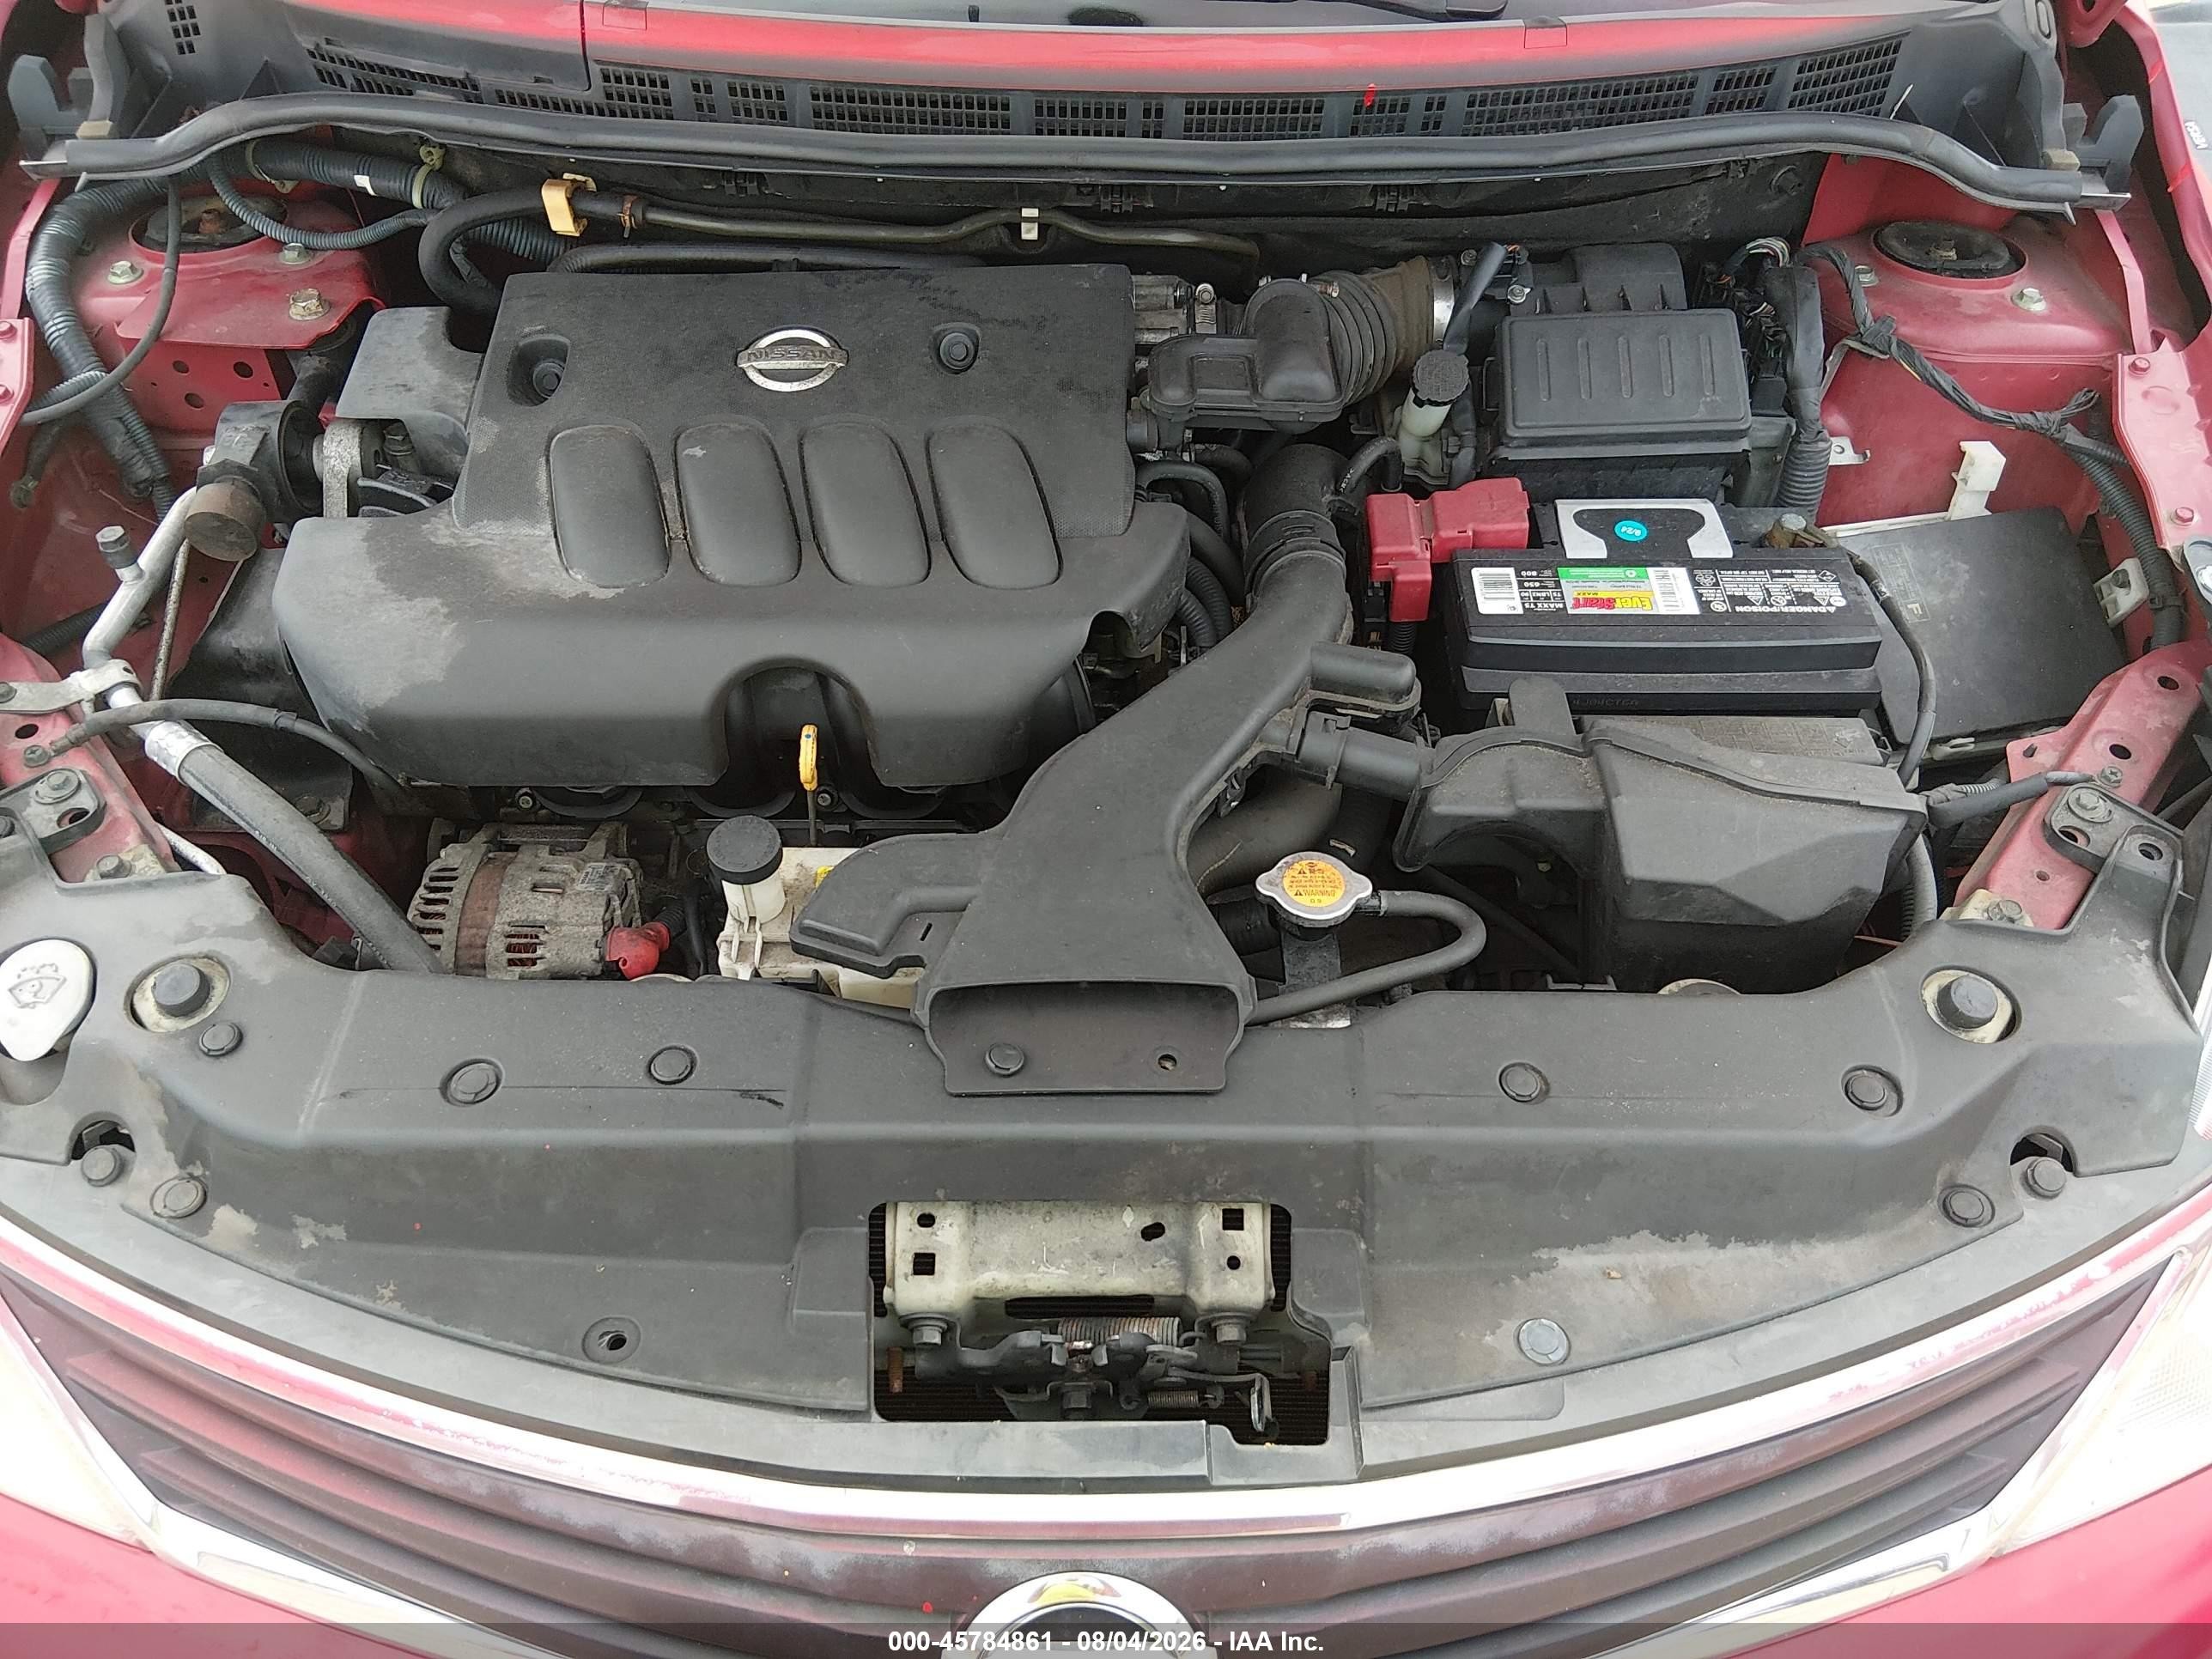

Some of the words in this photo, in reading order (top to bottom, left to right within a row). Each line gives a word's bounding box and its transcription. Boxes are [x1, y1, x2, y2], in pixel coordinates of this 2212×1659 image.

[2184, 122, 2209, 149] VERSA
[747, 347, 835, 361] NISSAN
[1572, 597, 1653, 611] EverStart
